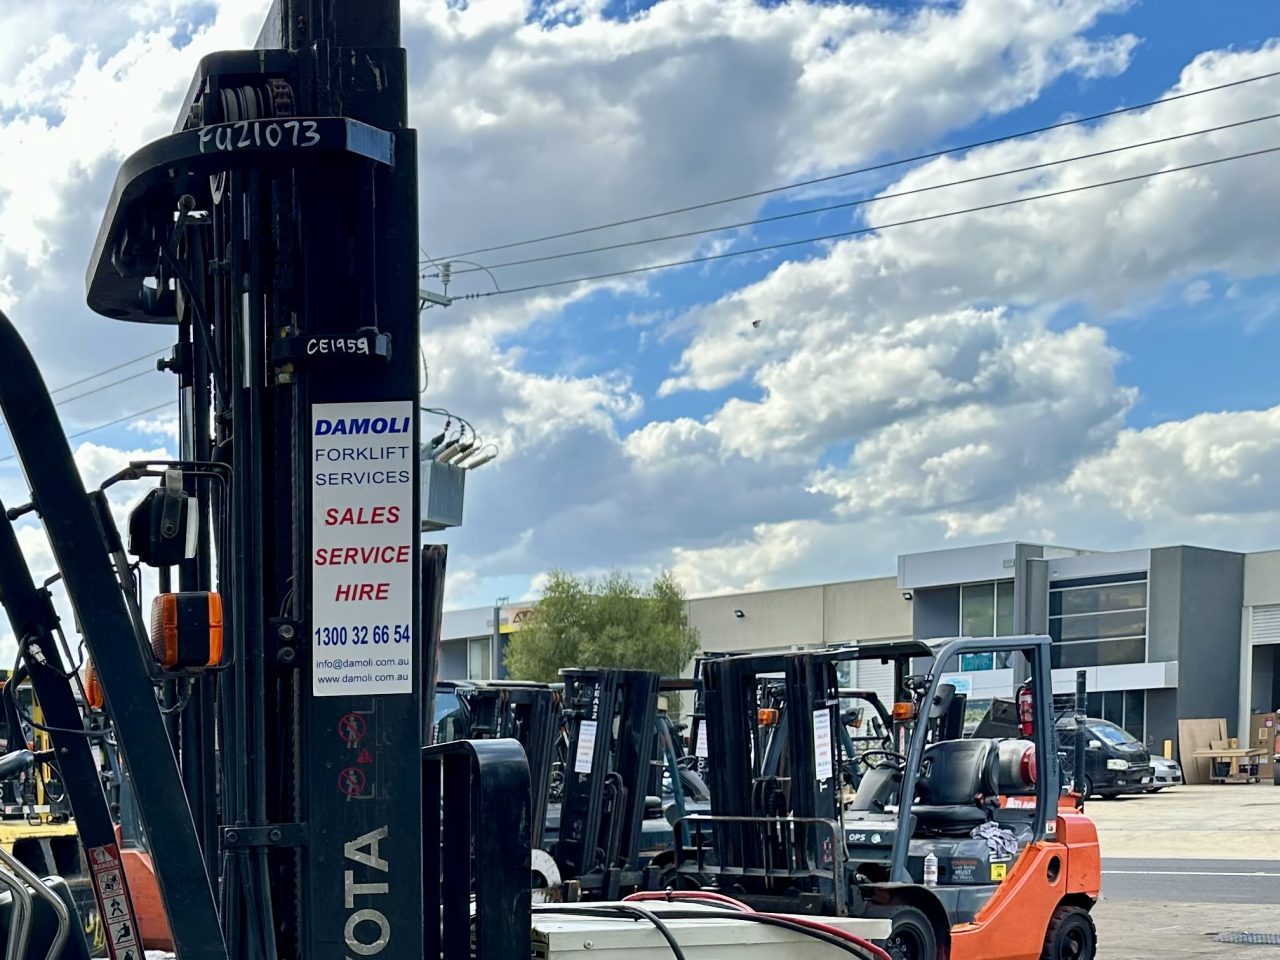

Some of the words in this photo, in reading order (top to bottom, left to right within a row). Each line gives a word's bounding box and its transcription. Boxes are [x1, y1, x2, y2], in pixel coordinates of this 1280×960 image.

[198, 120, 321, 153] FU21073
[314, 417, 410, 436] DAMOLI
[315, 446, 409, 461] FORKLIFT
[315, 470, 410, 486] SERVICES
[324, 506, 401, 526] SALES
[315, 545, 410, 566] SERVICE
[335, 583, 390, 602] HIRE
[315, 626, 347, 646] 1300
[352, 625, 368, 645] 32
[373, 625, 389, 644] 66
[393, 624, 410, 643] 54
[316, 657, 409, 670] info@damoli.com.au
[318, 672, 408, 684] www.damoli.com.au
[848, 833, 866, 841] OPS
[93, 860, 119, 870] DANGER
